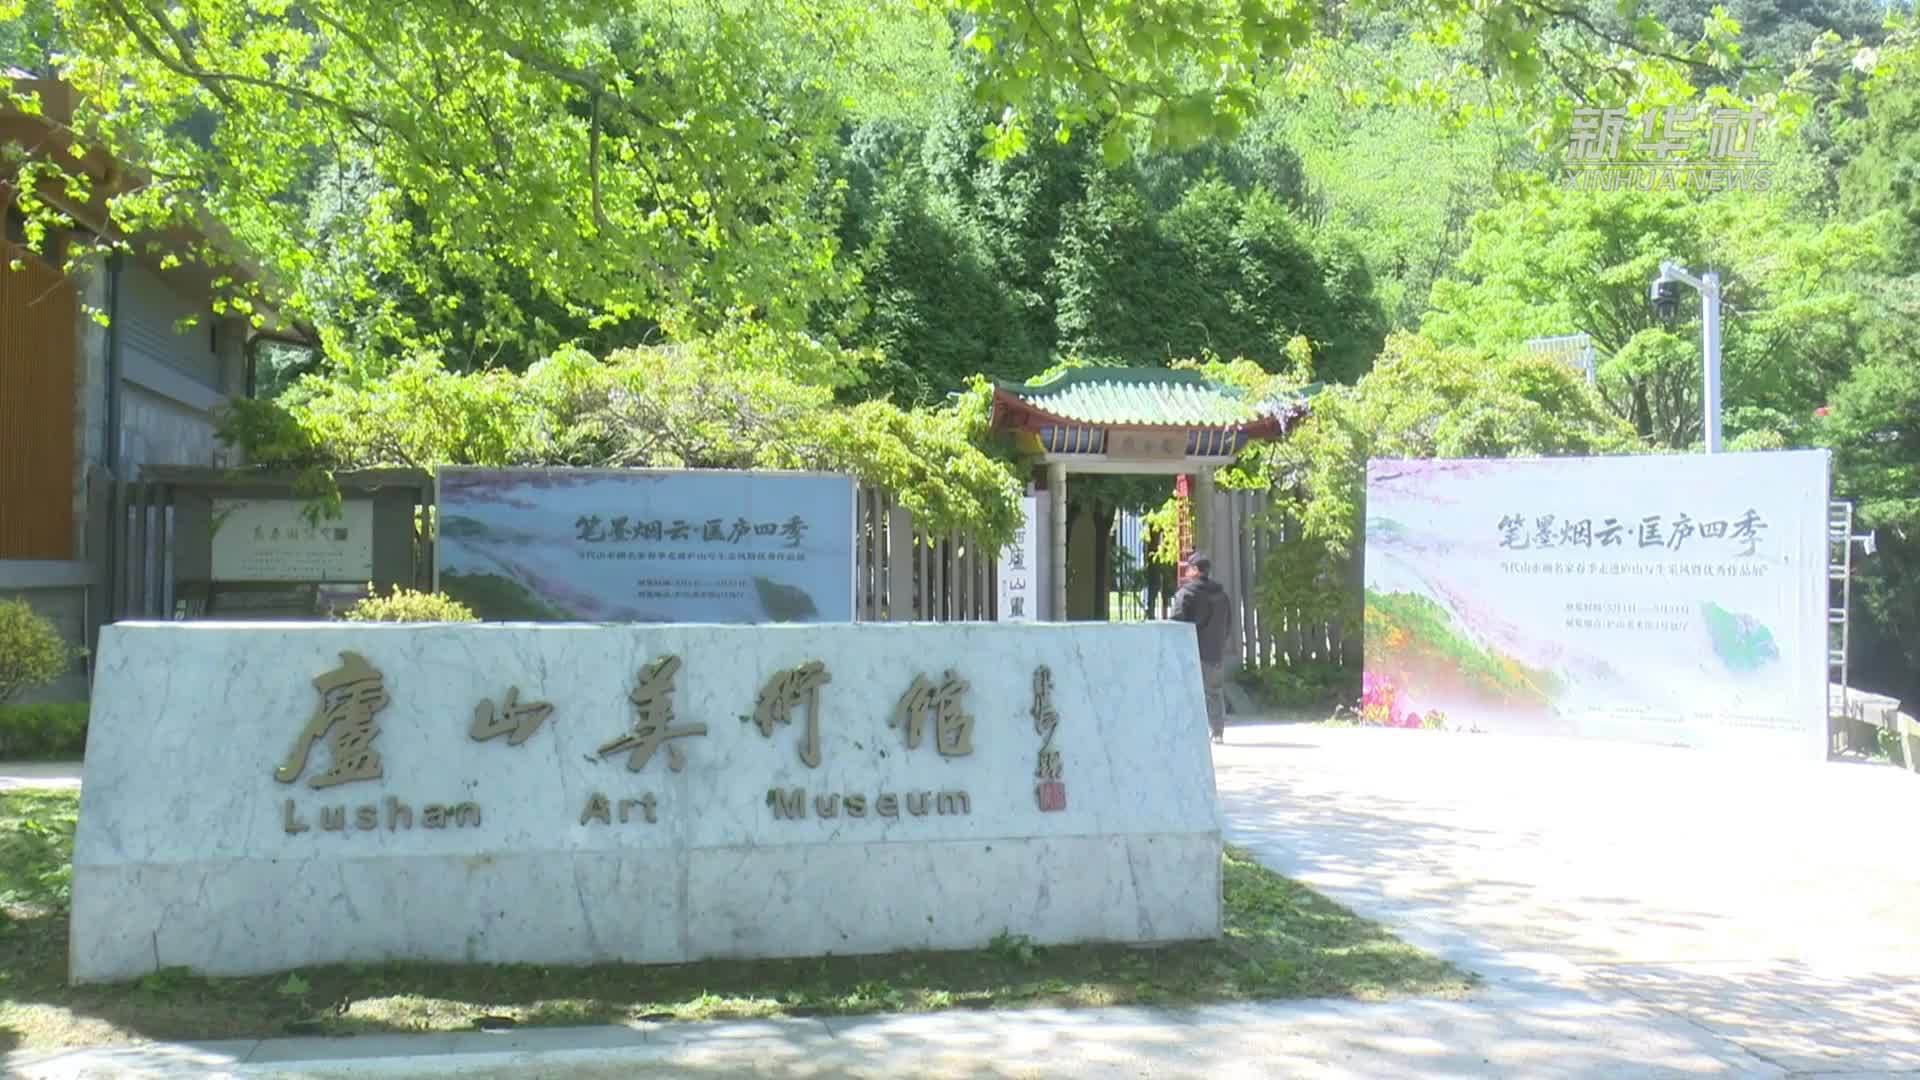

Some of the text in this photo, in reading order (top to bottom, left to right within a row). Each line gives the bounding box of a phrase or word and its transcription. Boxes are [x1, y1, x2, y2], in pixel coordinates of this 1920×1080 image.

[1498, 508, 1769, 557] 笔墨烟云·匡庐四季
[284, 786, 972, 833] Lushan Art Museum
